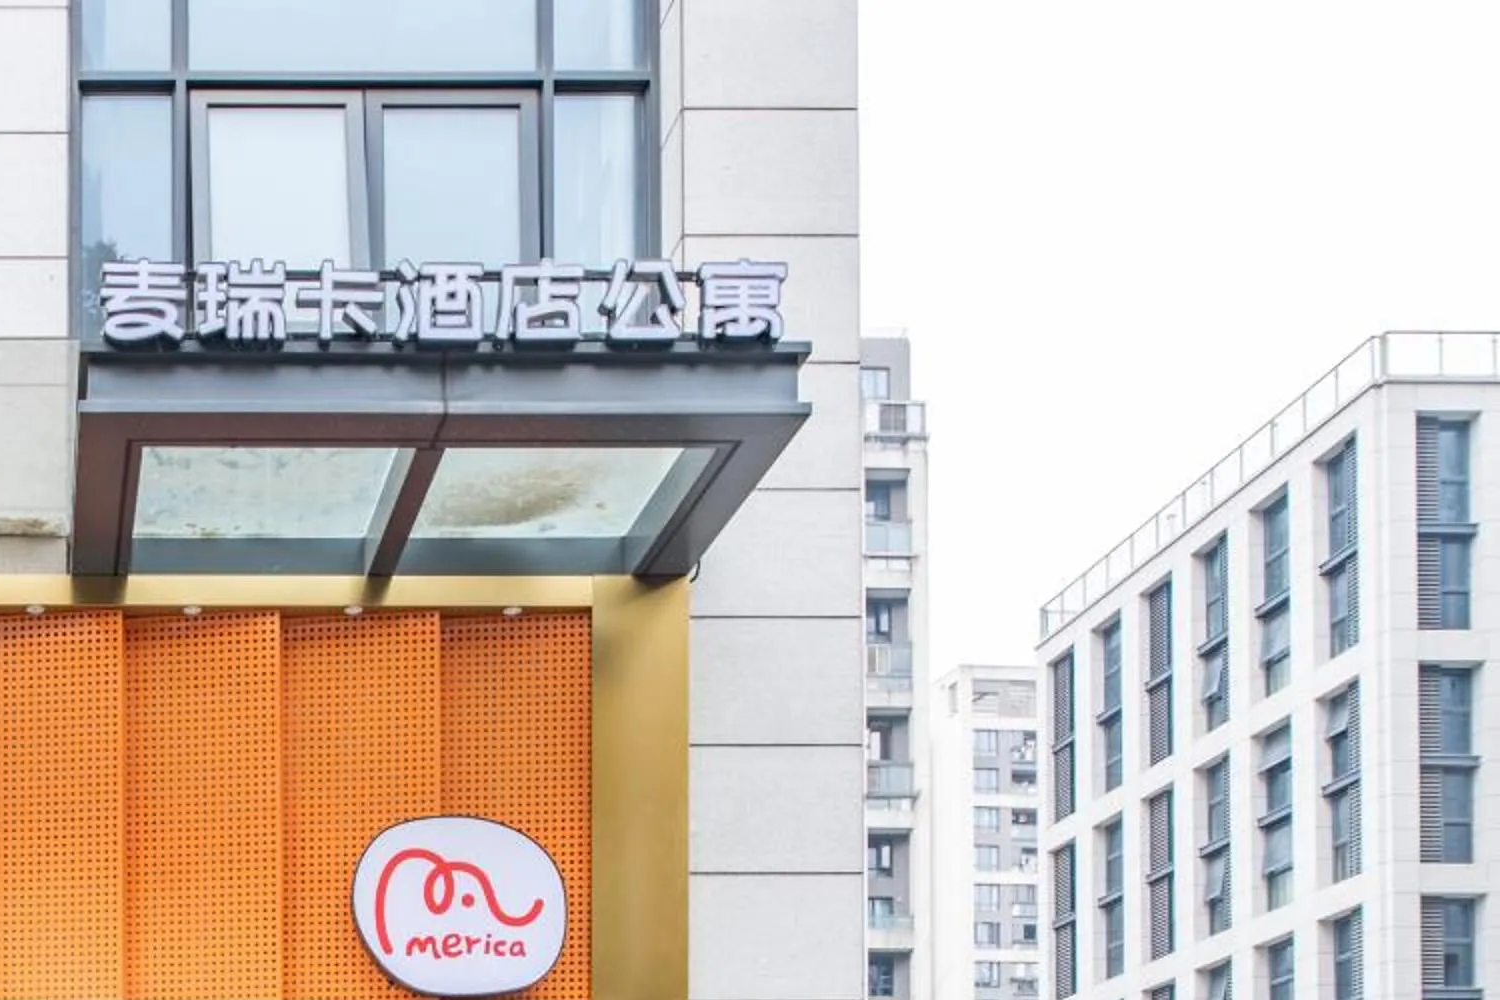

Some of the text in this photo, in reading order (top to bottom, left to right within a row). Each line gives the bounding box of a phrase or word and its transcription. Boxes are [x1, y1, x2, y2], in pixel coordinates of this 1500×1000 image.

[99, 258, 789, 346] 麦瑞卡酒店公寓
[405, 933, 528, 960] merica
